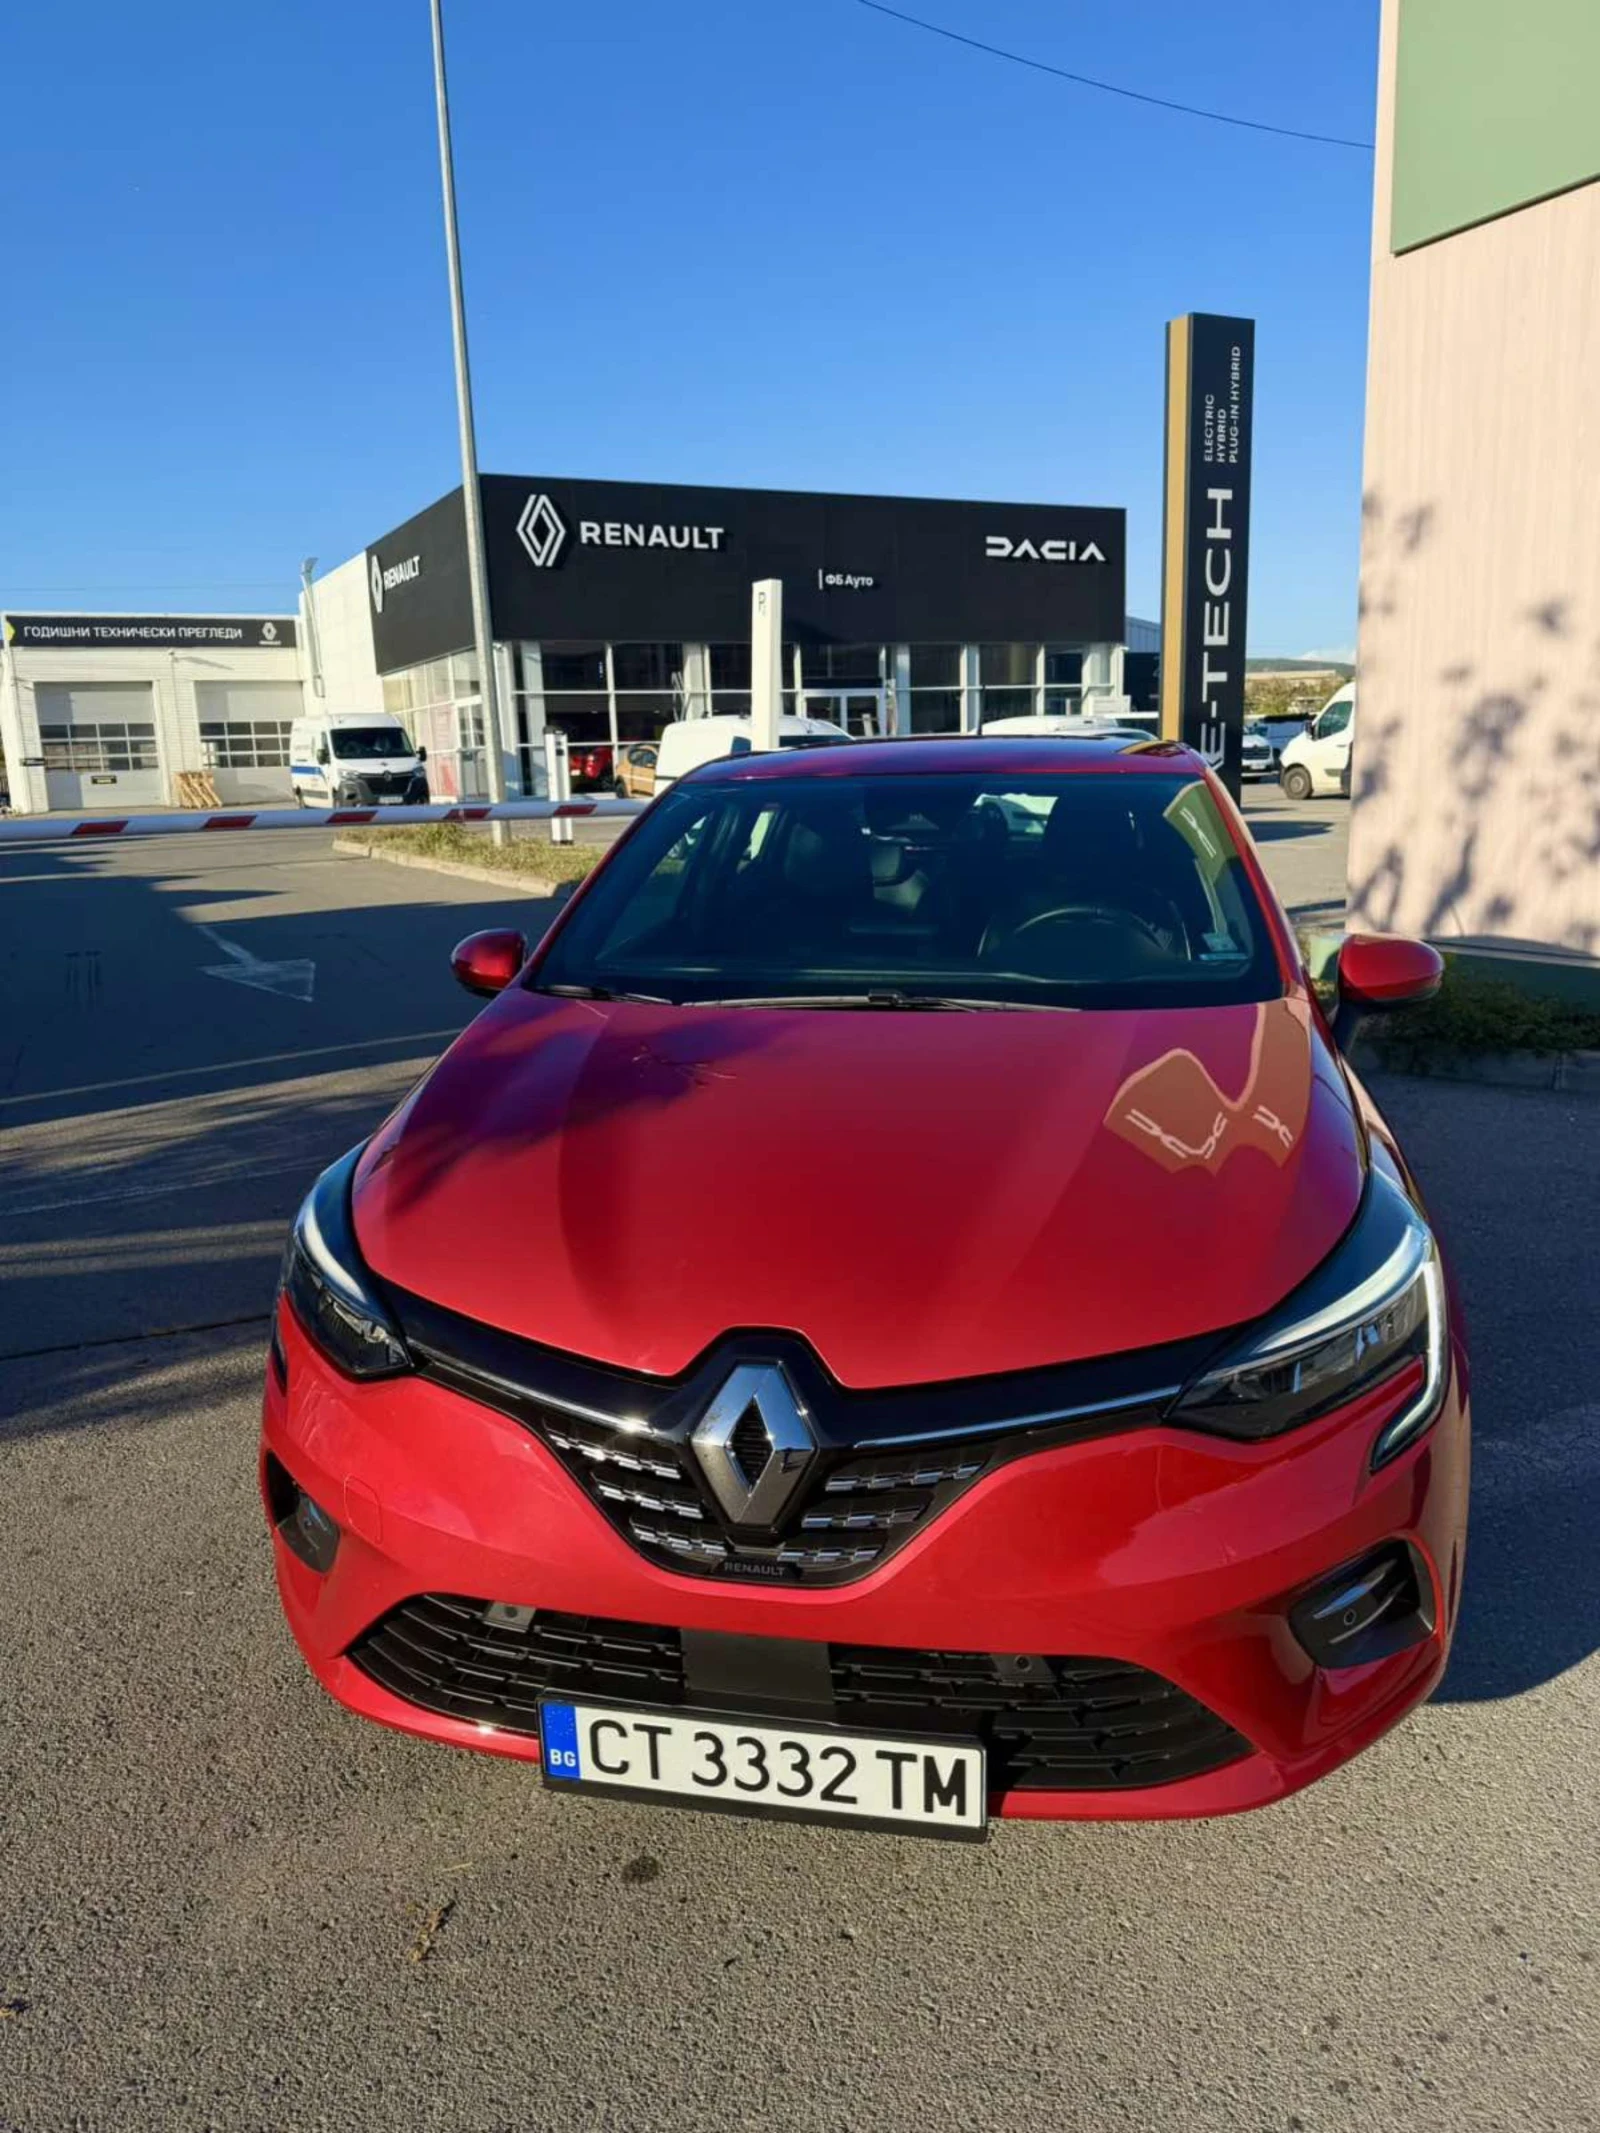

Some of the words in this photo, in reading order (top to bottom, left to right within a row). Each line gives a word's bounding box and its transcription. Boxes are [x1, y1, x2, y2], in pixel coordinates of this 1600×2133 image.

[1230, 346, 1241, 401] HYBRID
[1204, 394, 1215, 462] ELECTRIC
[1216, 408, 1227, 463] HYBRID
[1228, 404, 1239, 464] PLUG-IN
[580, 521, 724, 549] RENAULT
[985, 536, 1107, 562] DACIA
[383, 555, 420, 590] RENAULT
[825, 574, 844, 586] ФБ
[845, 574, 874, 589] Ауто
[23, 626, 91, 638] ГОДИШНИ
[92, 626, 176, 639] ТЕХНИЧЕСКИ
[178, 627, 243, 639] ПРЕГЛЕДИ
[1200, 488, 1233, 771] E-TECH
[724, 1562, 785, 1576] RENAULT
[549, 1747, 577, 1768] BG
[588, 1718, 673, 1781] CT
[691, 1730, 859, 1805] 3332
[875, 1749, 967, 1817] TM
